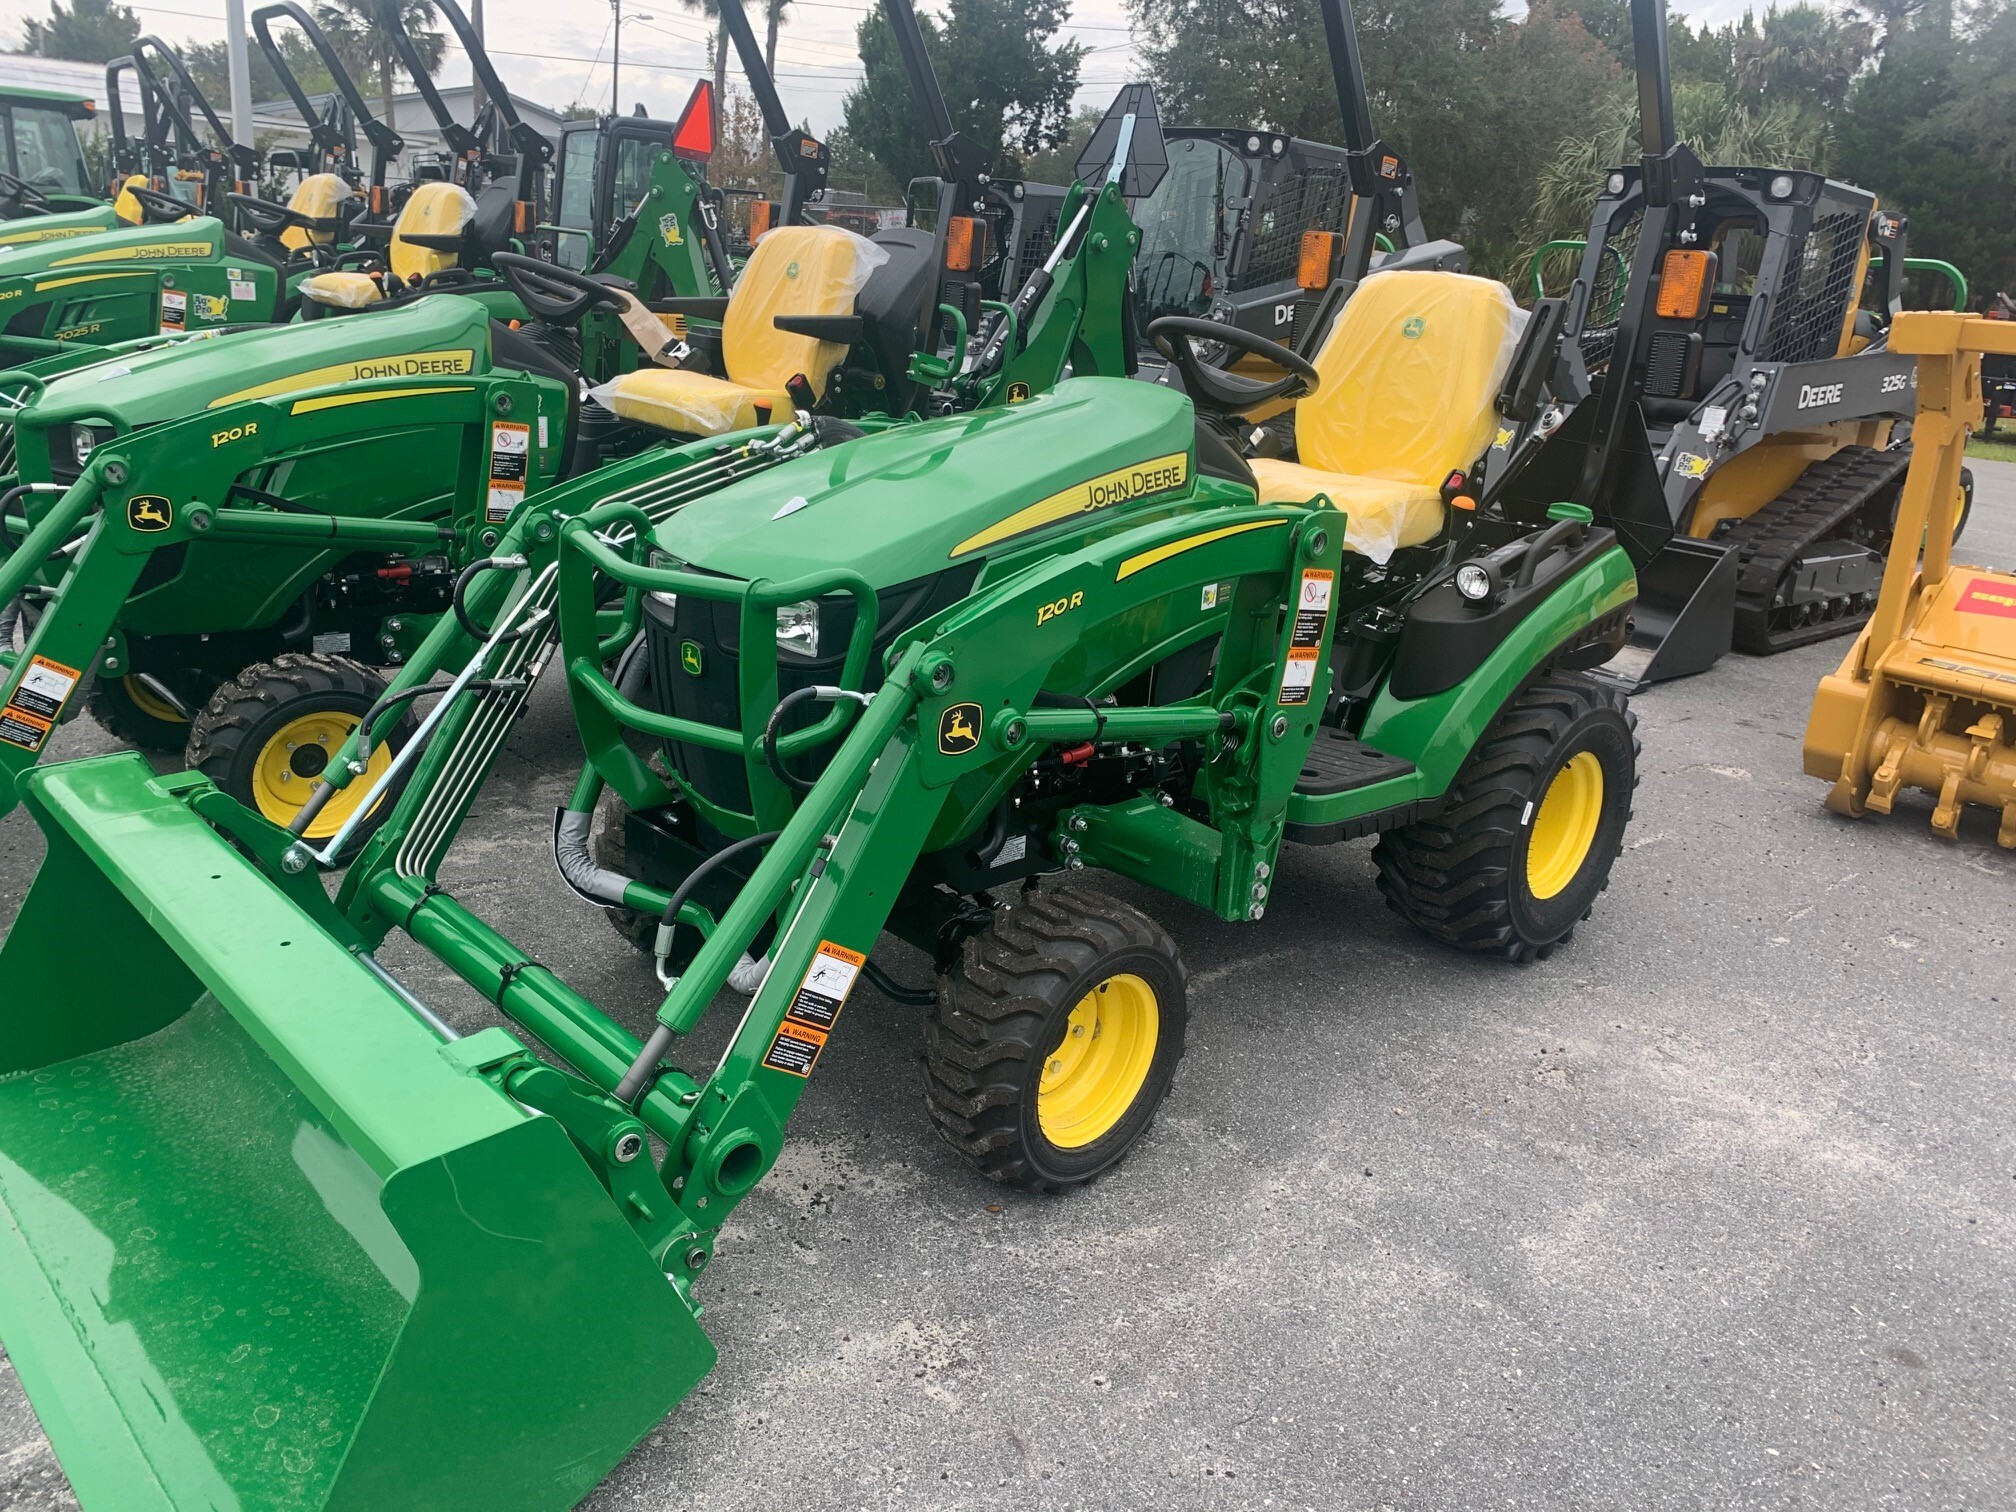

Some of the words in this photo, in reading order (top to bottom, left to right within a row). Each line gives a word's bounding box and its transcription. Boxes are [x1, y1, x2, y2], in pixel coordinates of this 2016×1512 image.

[39, 231, 67, 241] JOHN
[132, 248, 165, 258] JOHN
[168, 246, 206, 256] DEERE
[14, 289, 22, 297] R
[54, 326, 89, 342] 2025
[91, 323, 100, 333] R
[350, 363, 400, 382] JOHN
[405, 358, 464, 375] DEERE
[1798, 383, 1844, 409] DEERE
[1881, 374, 1907, 393] 325G
[500, 423, 528, 431] WARNING
[211, 425, 244, 449] 120
[244, 422, 258, 436] R
[496, 482, 524, 491] WARNING
[1084, 479, 1129, 510] JOHN
[1132, 466, 1181, 494] DEERE
[1309, 571, 1332, 580] WARNING
[1036, 597, 1068, 627] 120
[1069, 590, 1084, 611] R
[1294, 651, 1317, 660] WARNING
[45, 662, 75, 677] WARNING
[15, 714, 46, 728] WARNING
[831, 947, 860, 963] WARNING
[792, 1028, 821, 1043] WARNING
